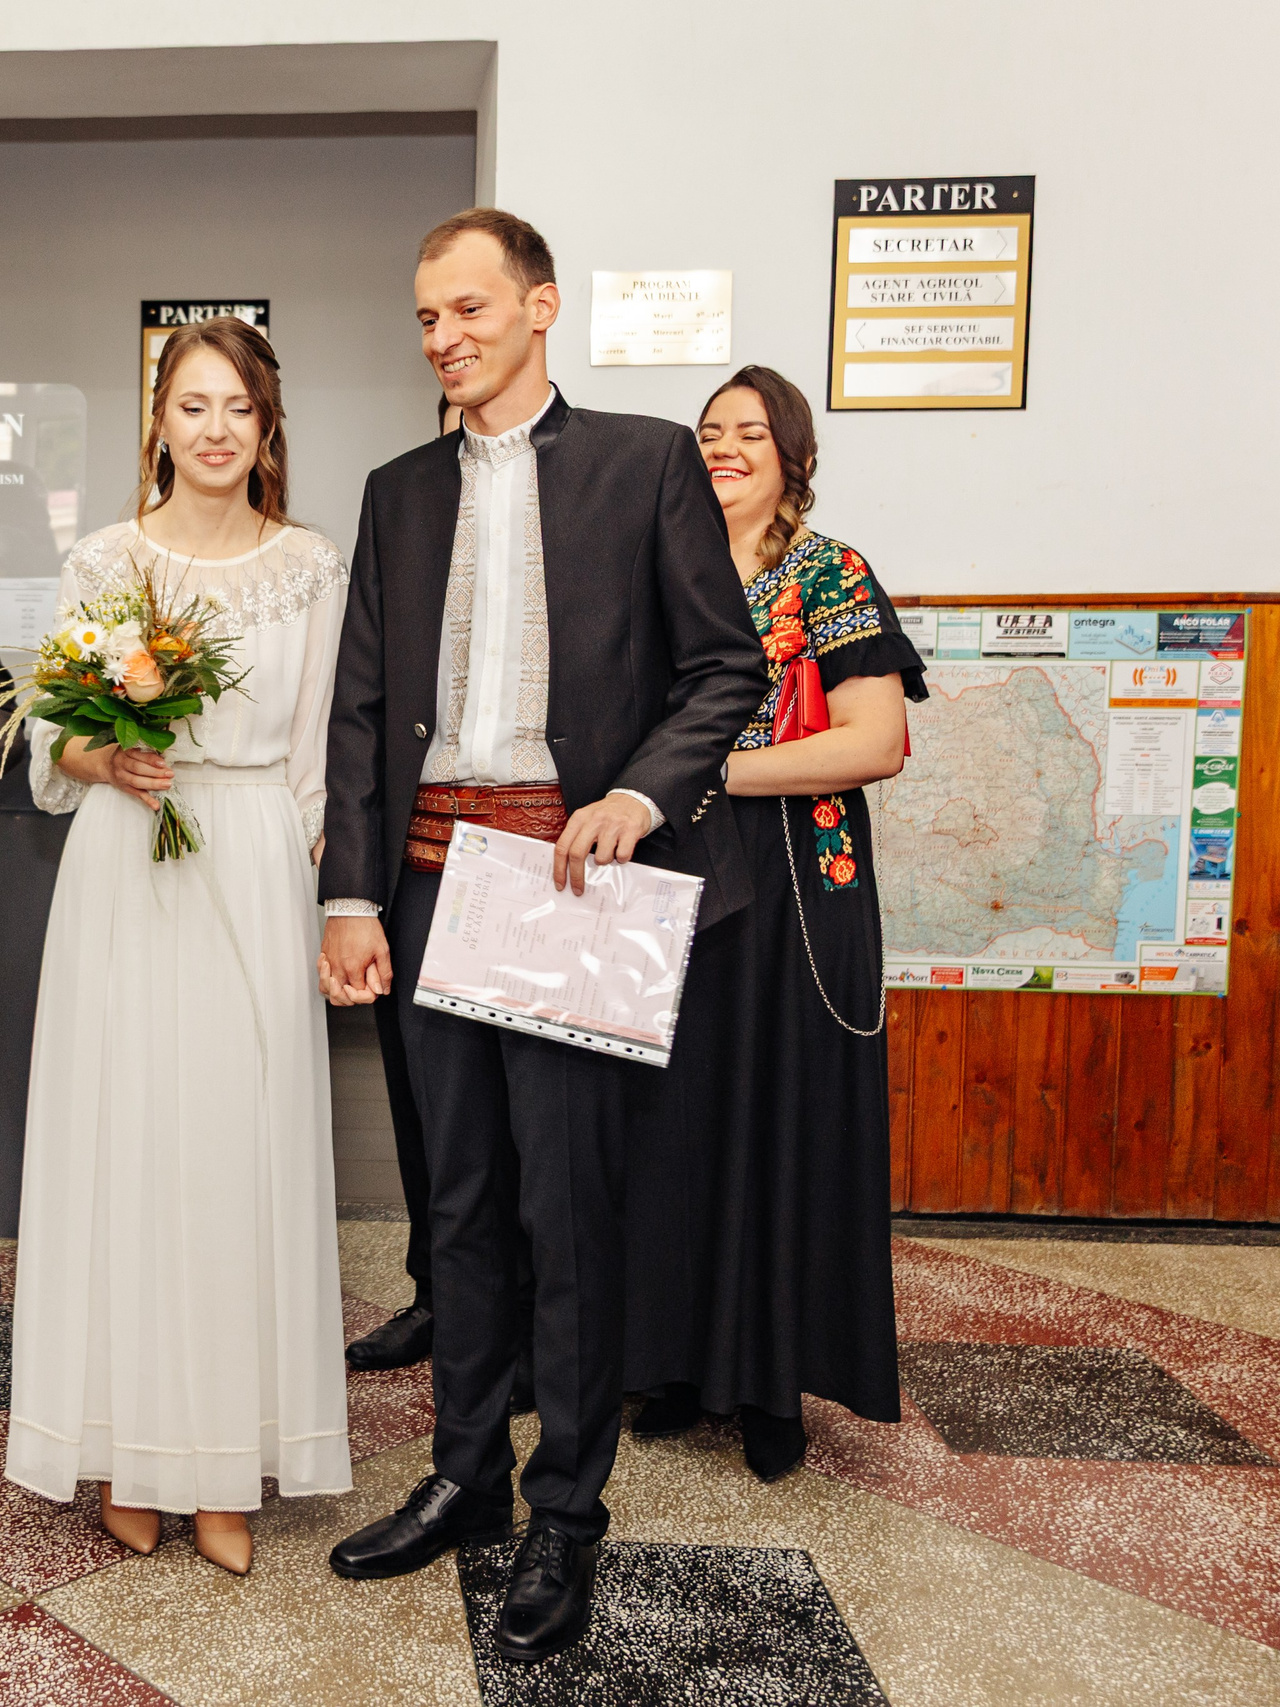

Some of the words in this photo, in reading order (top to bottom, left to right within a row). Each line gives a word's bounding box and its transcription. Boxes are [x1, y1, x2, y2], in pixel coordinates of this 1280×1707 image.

[858, 183, 998, 212] PARTER
[872, 238, 975, 253] SECRETAR
[632, 280, 691, 290] PROGRAM
[862, 279, 911, 290] AGENT
[917, 277, 984, 290] AGRICOL
[870, 291, 916, 303] STARE
[922, 289, 973, 302] CIVILĂ
[926, 324, 980, 334] SERVICIU
[880, 336, 942, 346] FINANCIAR
[945, 335, 1004, 346] CONTABIL
[461, 875, 483, 943] CERTIFICAT
[469, 936, 478, 950] DE
